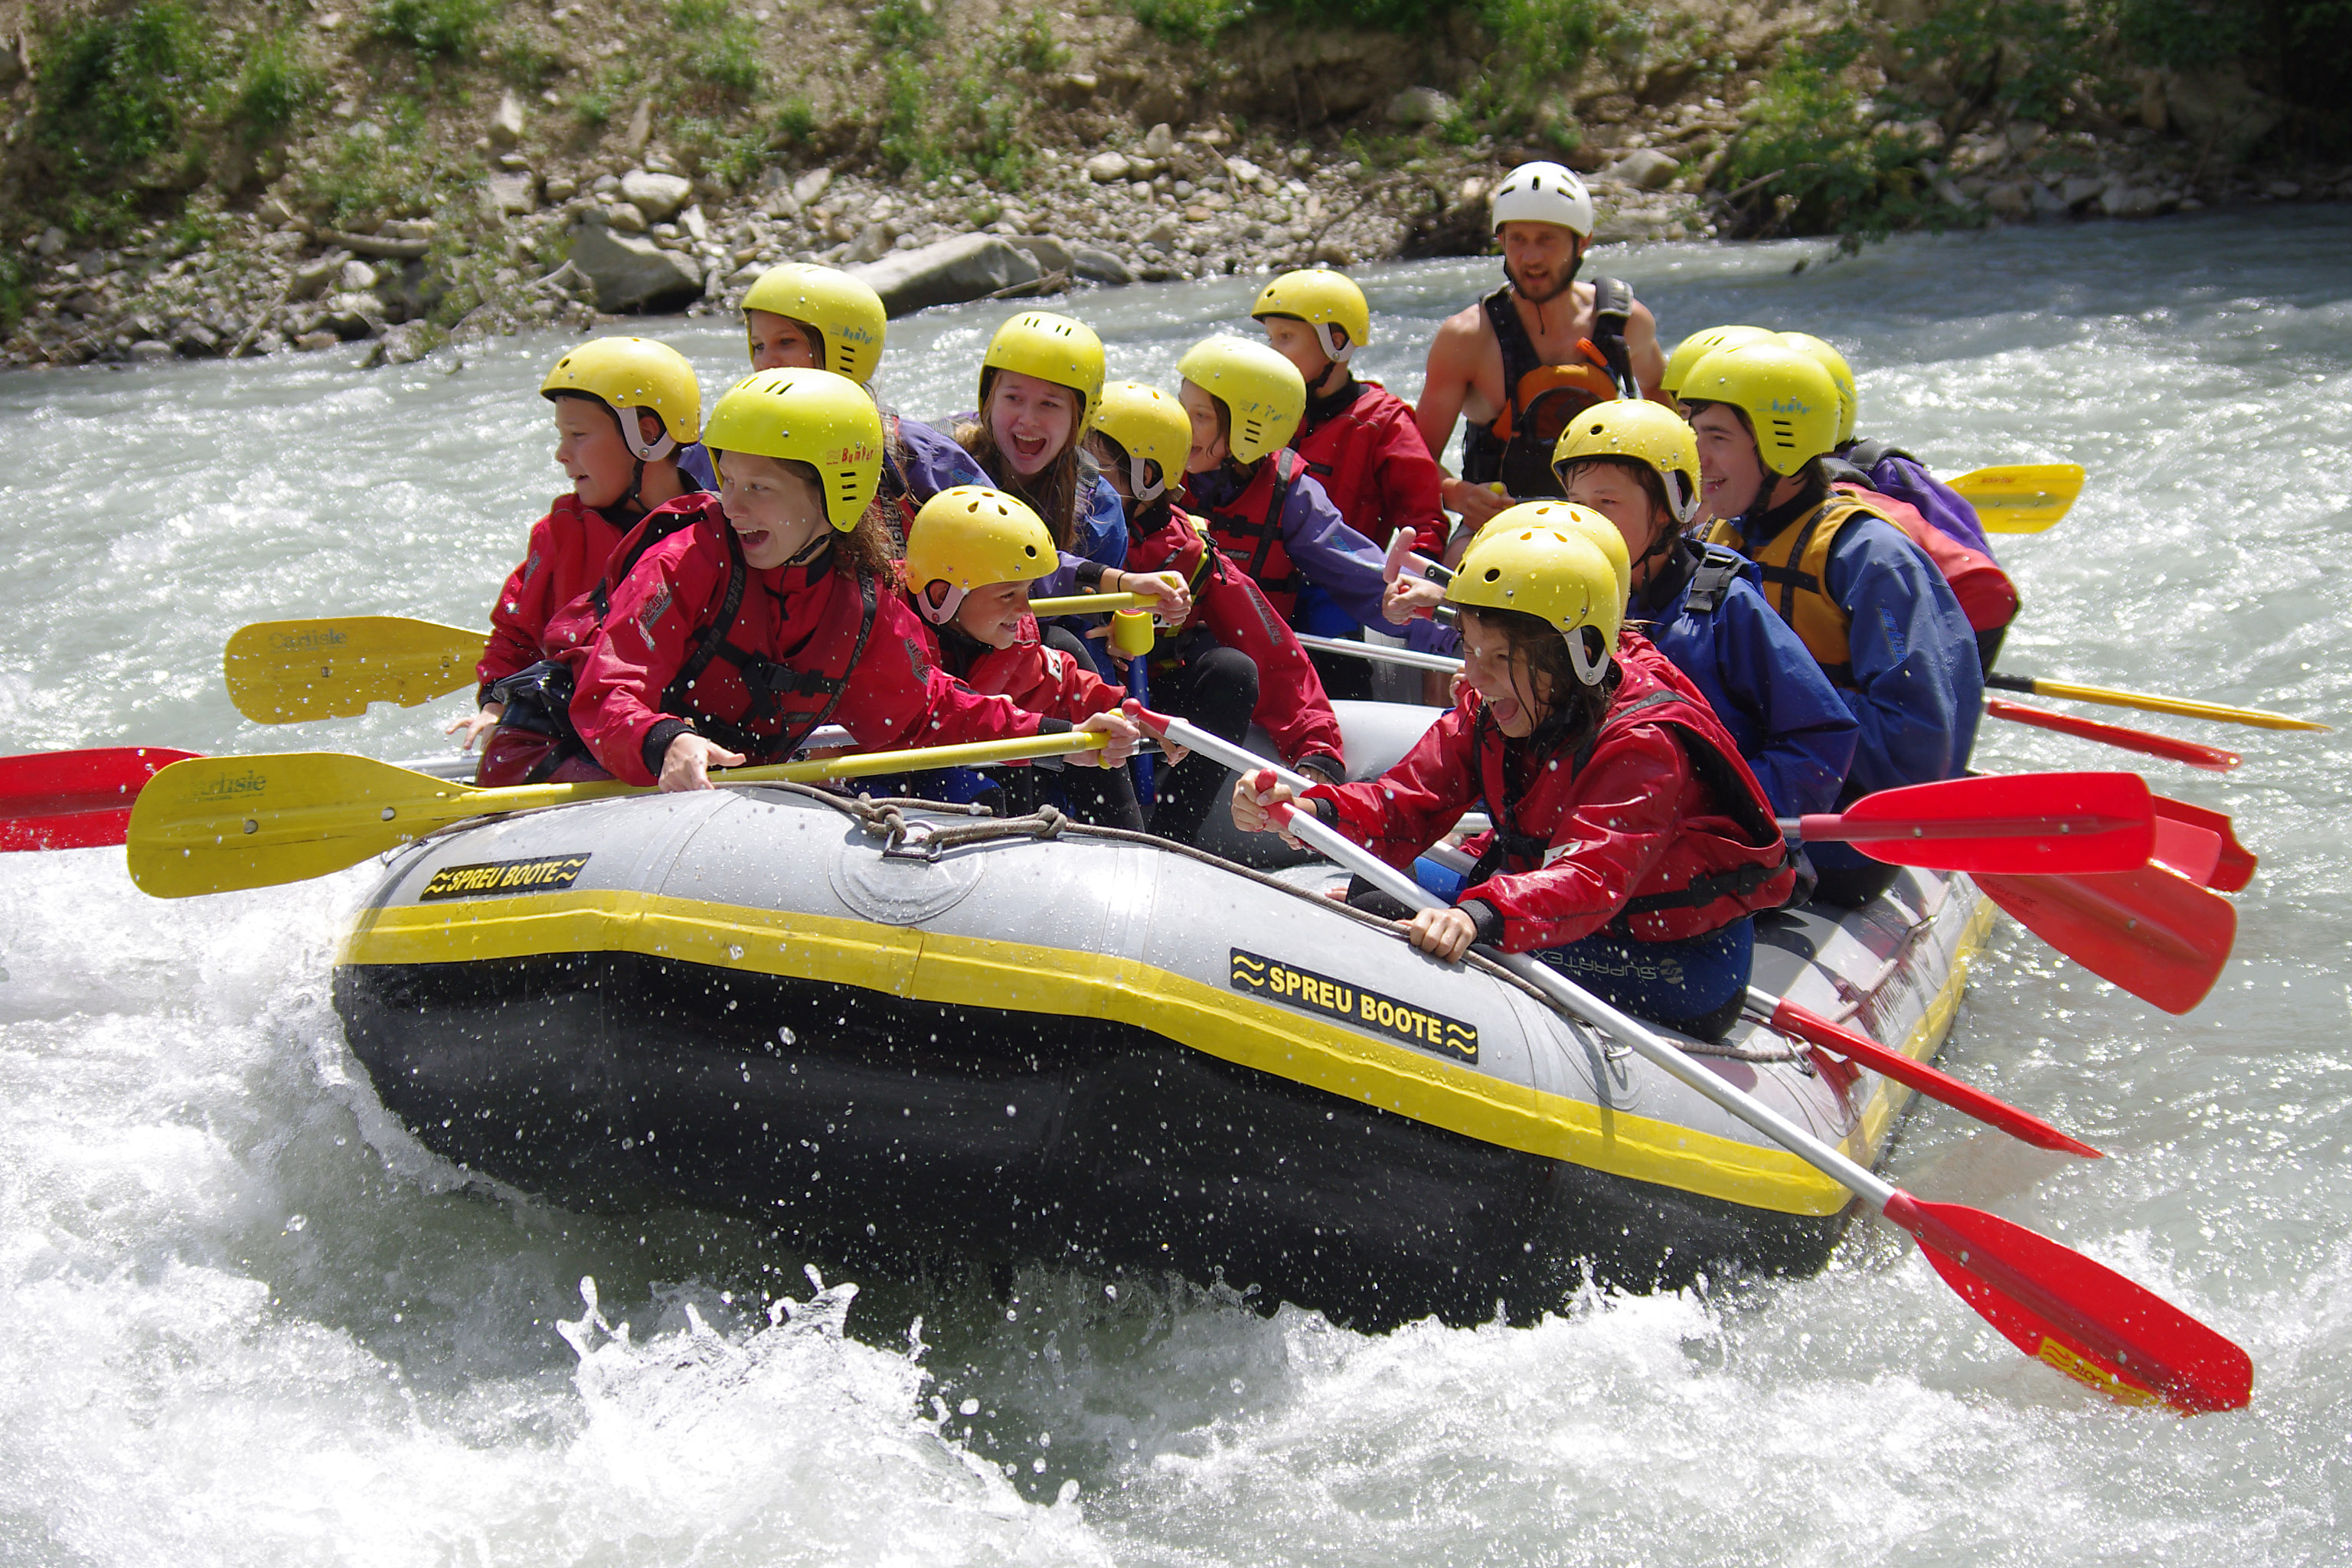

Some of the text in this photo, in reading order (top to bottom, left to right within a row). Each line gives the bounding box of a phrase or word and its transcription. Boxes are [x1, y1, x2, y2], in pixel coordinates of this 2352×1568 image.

[446, 861, 564, 892] SPREU BOOTE
[1533, 949, 1658, 980] SUPRATEX
[1269, 966, 1442, 1044] SPREU BOOTE
